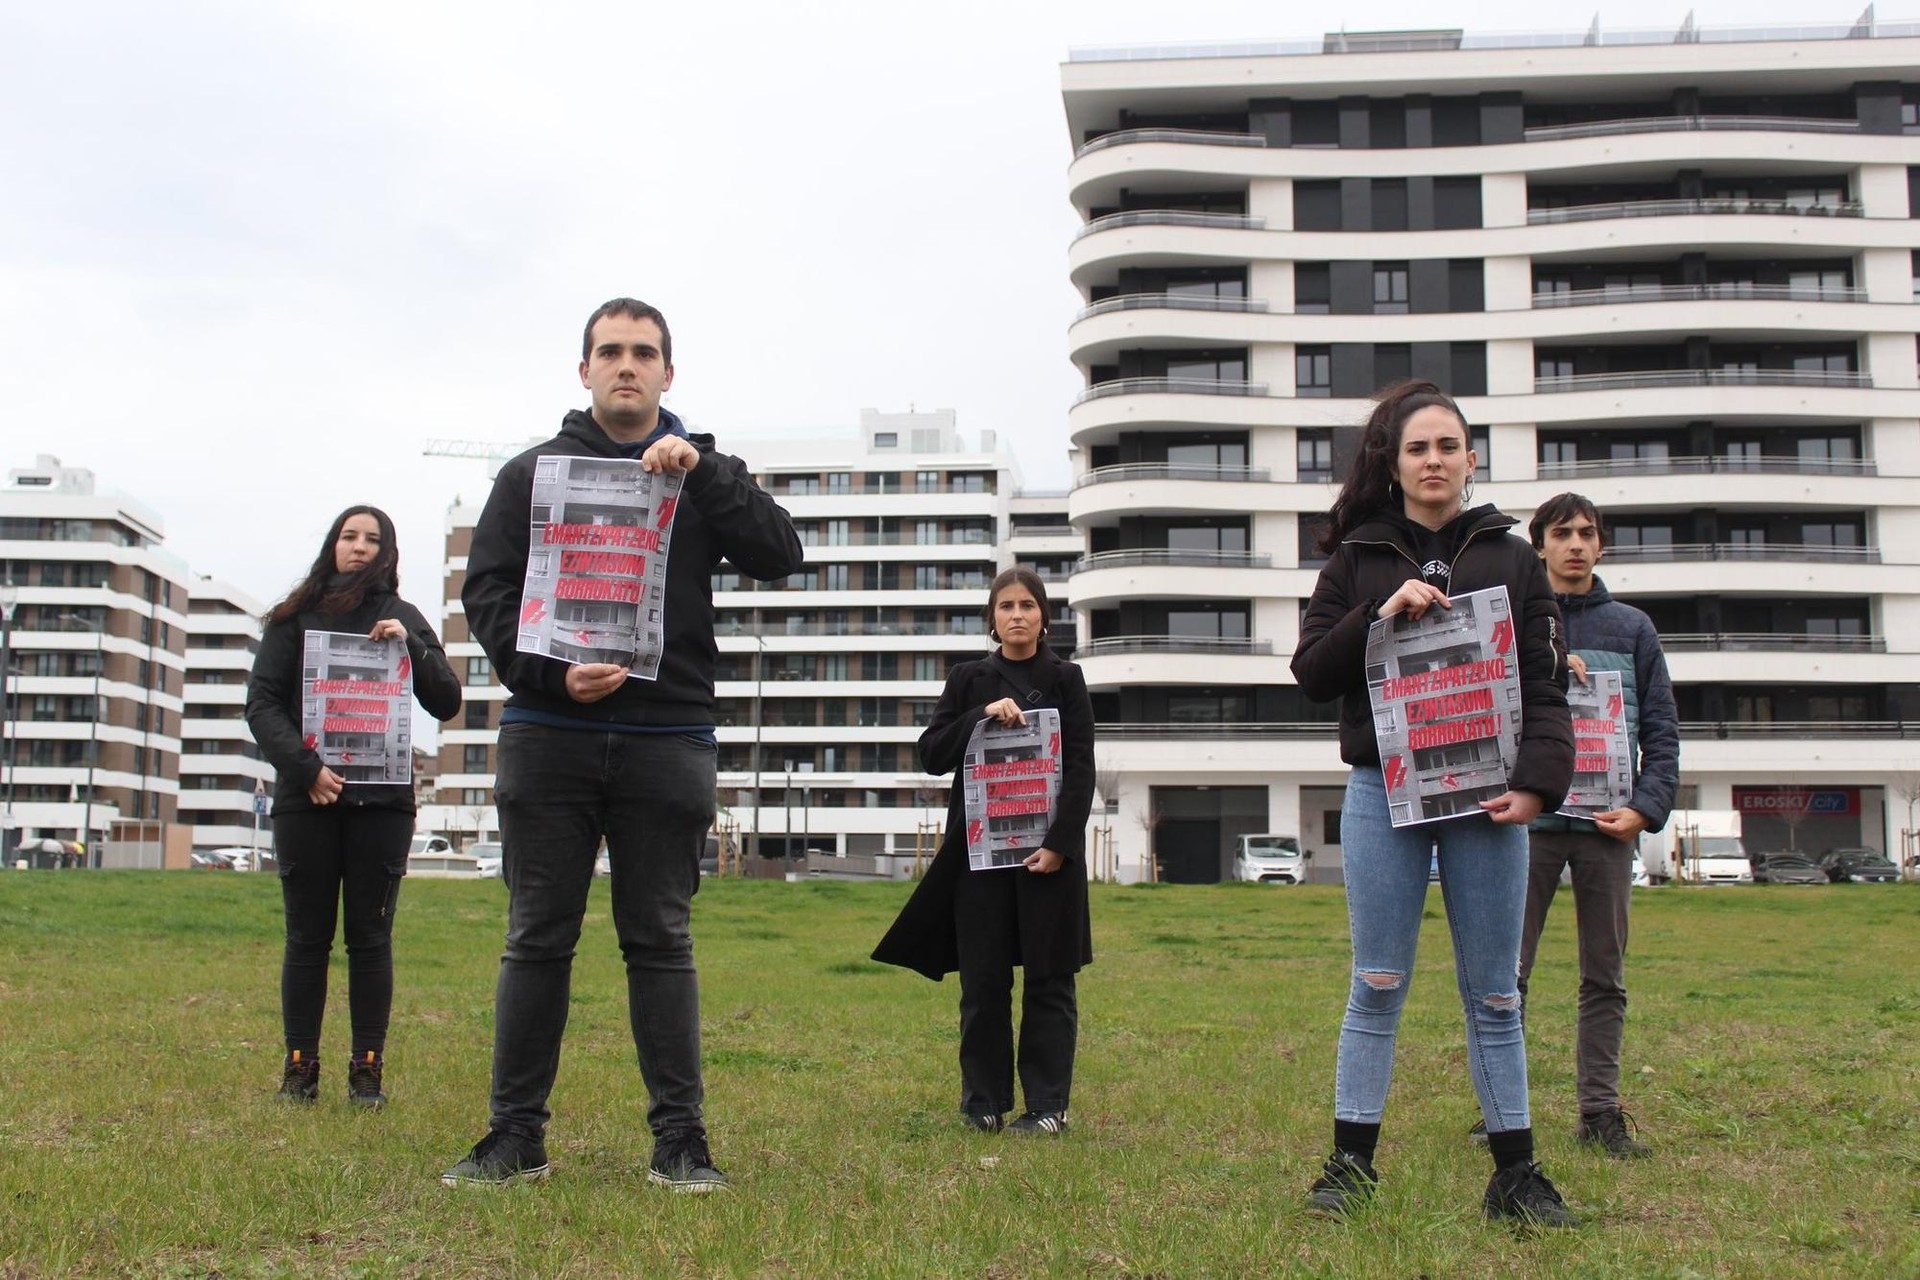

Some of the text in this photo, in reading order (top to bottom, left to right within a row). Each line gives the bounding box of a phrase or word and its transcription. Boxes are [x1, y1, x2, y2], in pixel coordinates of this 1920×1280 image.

[543, 522, 661, 553] EMANTZIPATZEKO
[560, 551, 646, 577] EZINTASUNA
[1383, 657, 1505, 701] EMANTZIPATZEKO
[1405, 687, 1494, 725] EZINTASUNA
[1743, 795, 1840, 811] EROSKI city
